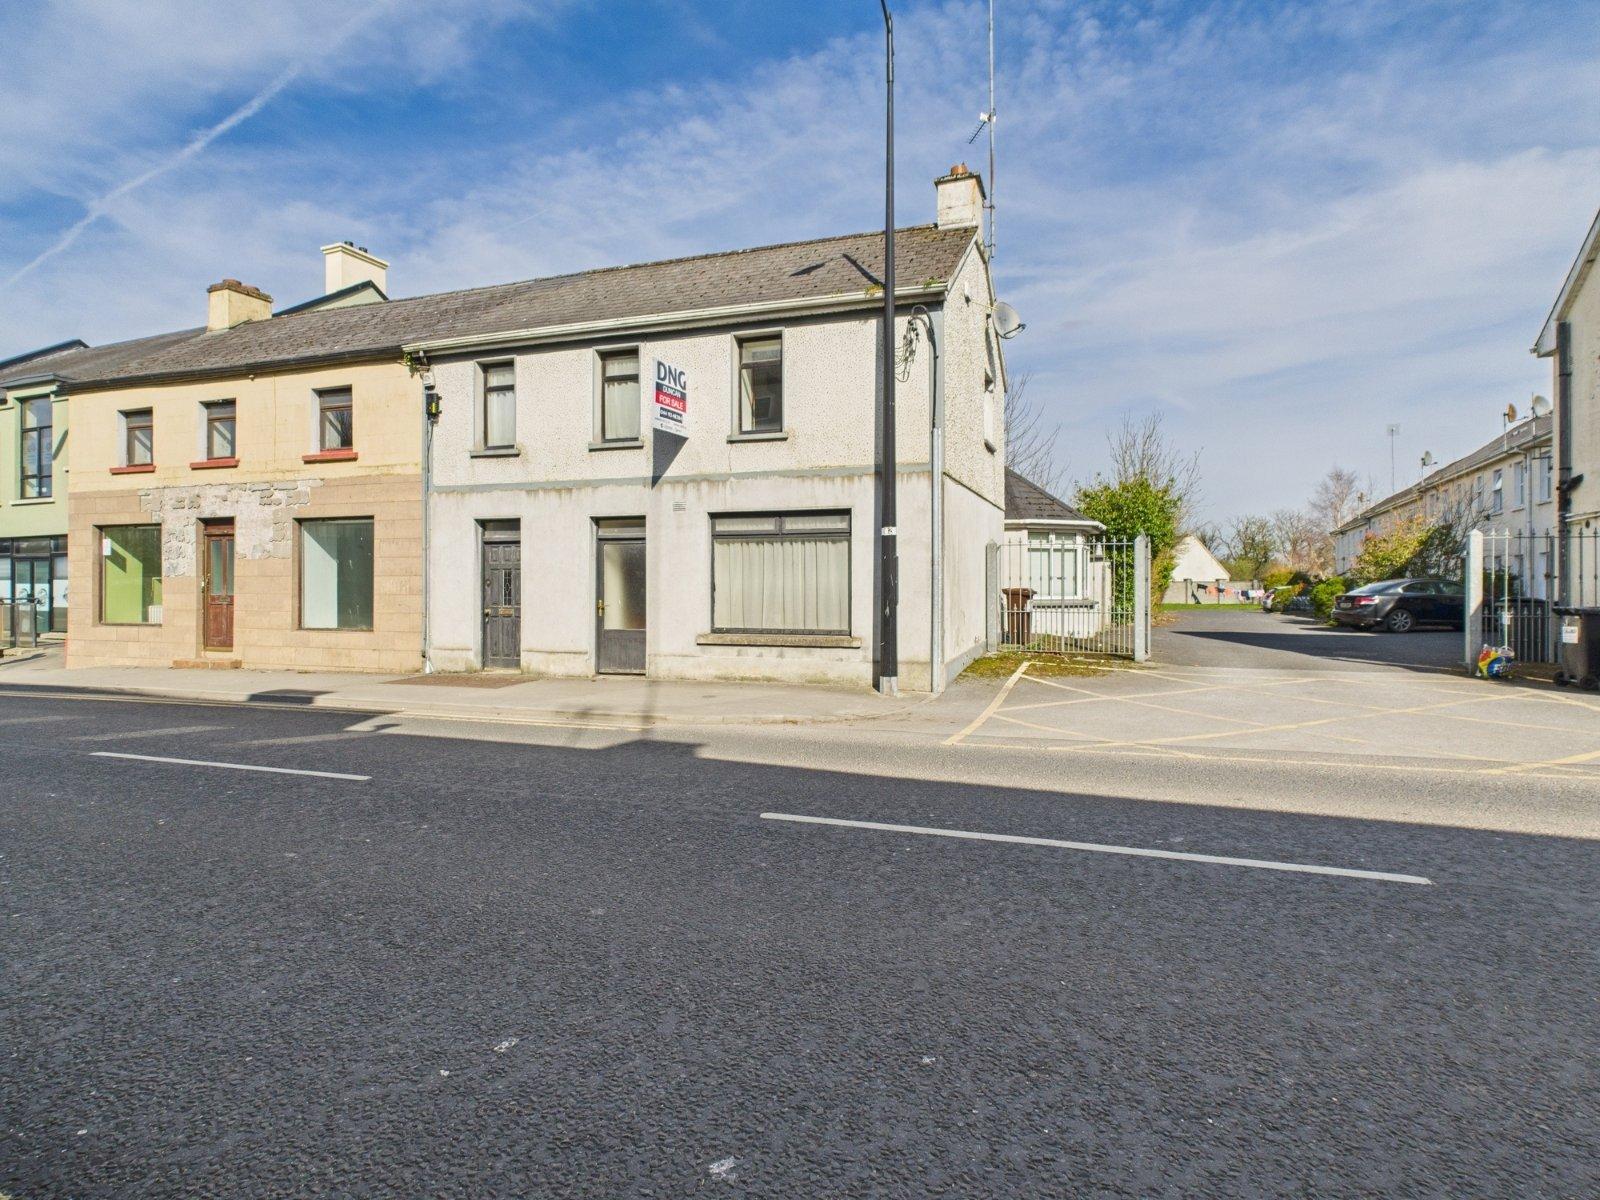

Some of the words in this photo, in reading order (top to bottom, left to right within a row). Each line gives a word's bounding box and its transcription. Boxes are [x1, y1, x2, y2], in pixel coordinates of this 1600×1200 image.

[657, 360, 687, 391] DNG
[659, 394, 671, 406] FOR
[671, 399, 684, 410] SALE
